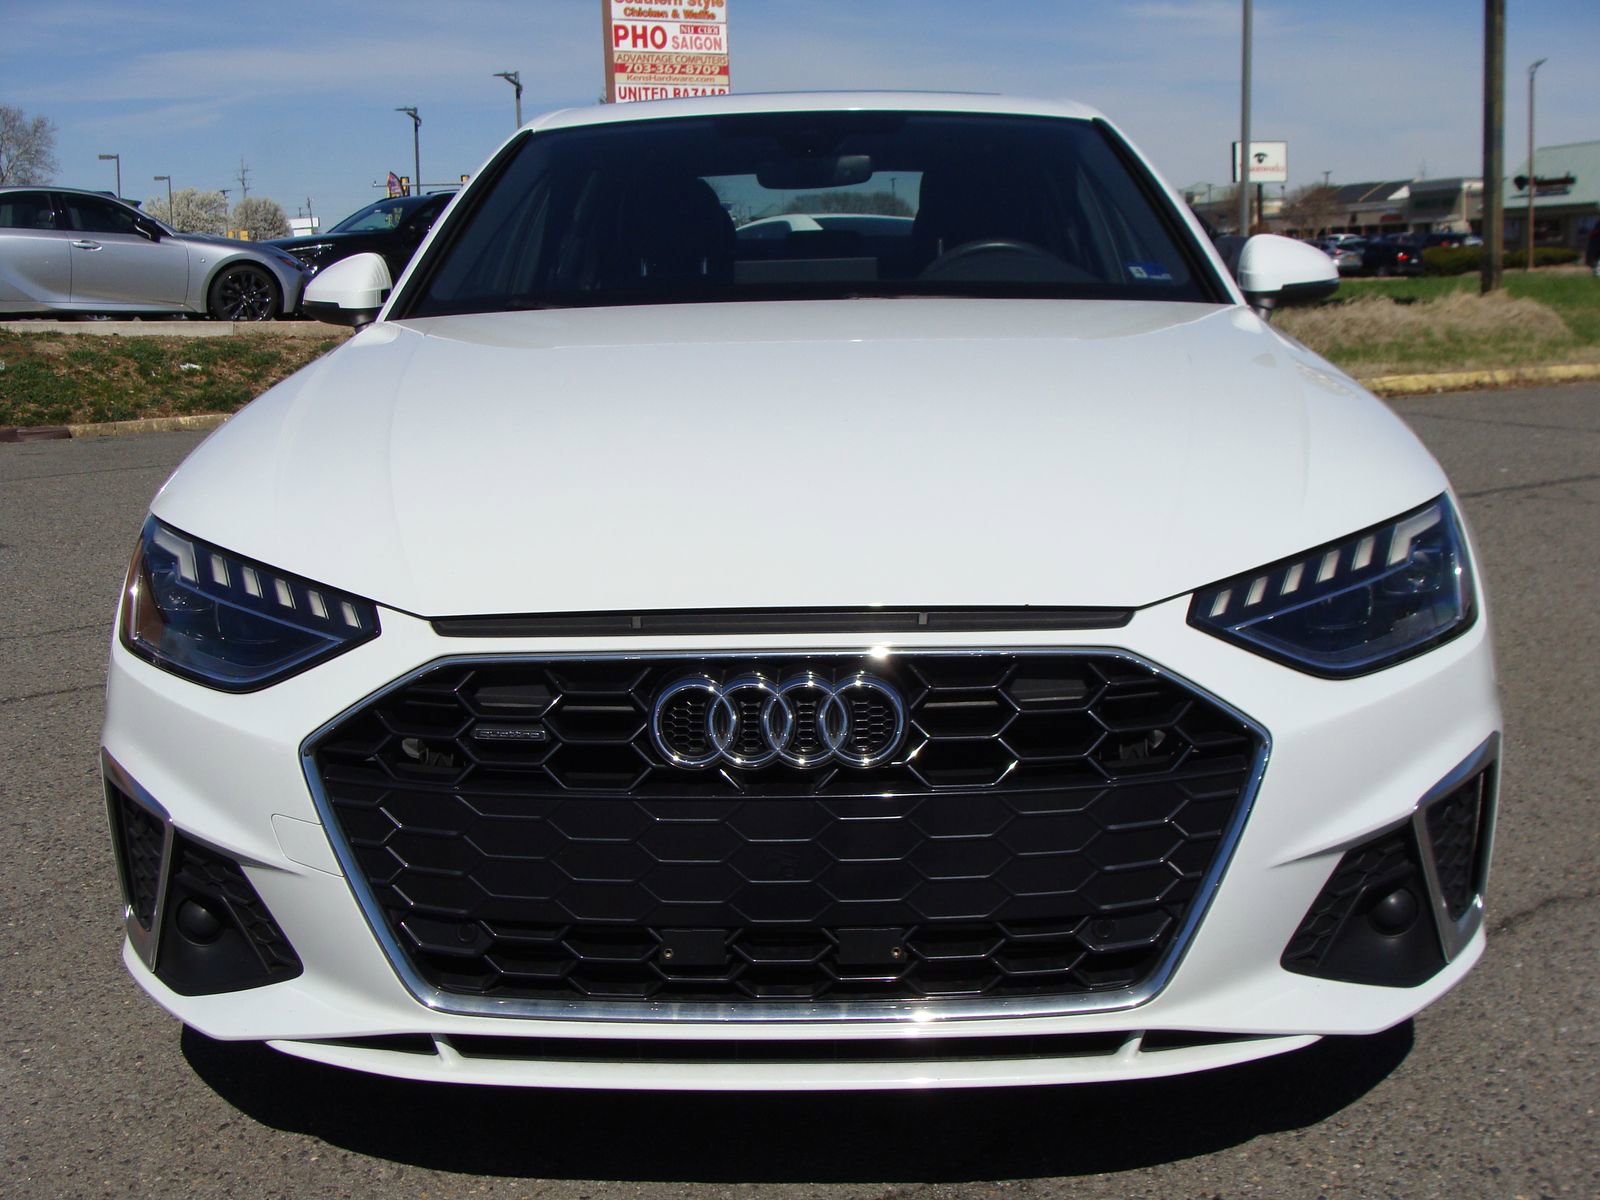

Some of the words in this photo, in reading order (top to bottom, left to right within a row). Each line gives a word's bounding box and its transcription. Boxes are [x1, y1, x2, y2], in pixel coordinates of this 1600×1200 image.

[613, 24, 667, 49] PHO
[672, 35, 722, 51] SAIGON
[616, 54, 673, 64] ADVANTAGE
[675, 55, 727, 65] COMPUTERS
[625, 63, 720, 74] 703-367-8709
[618, 86, 668, 101] UNITED
